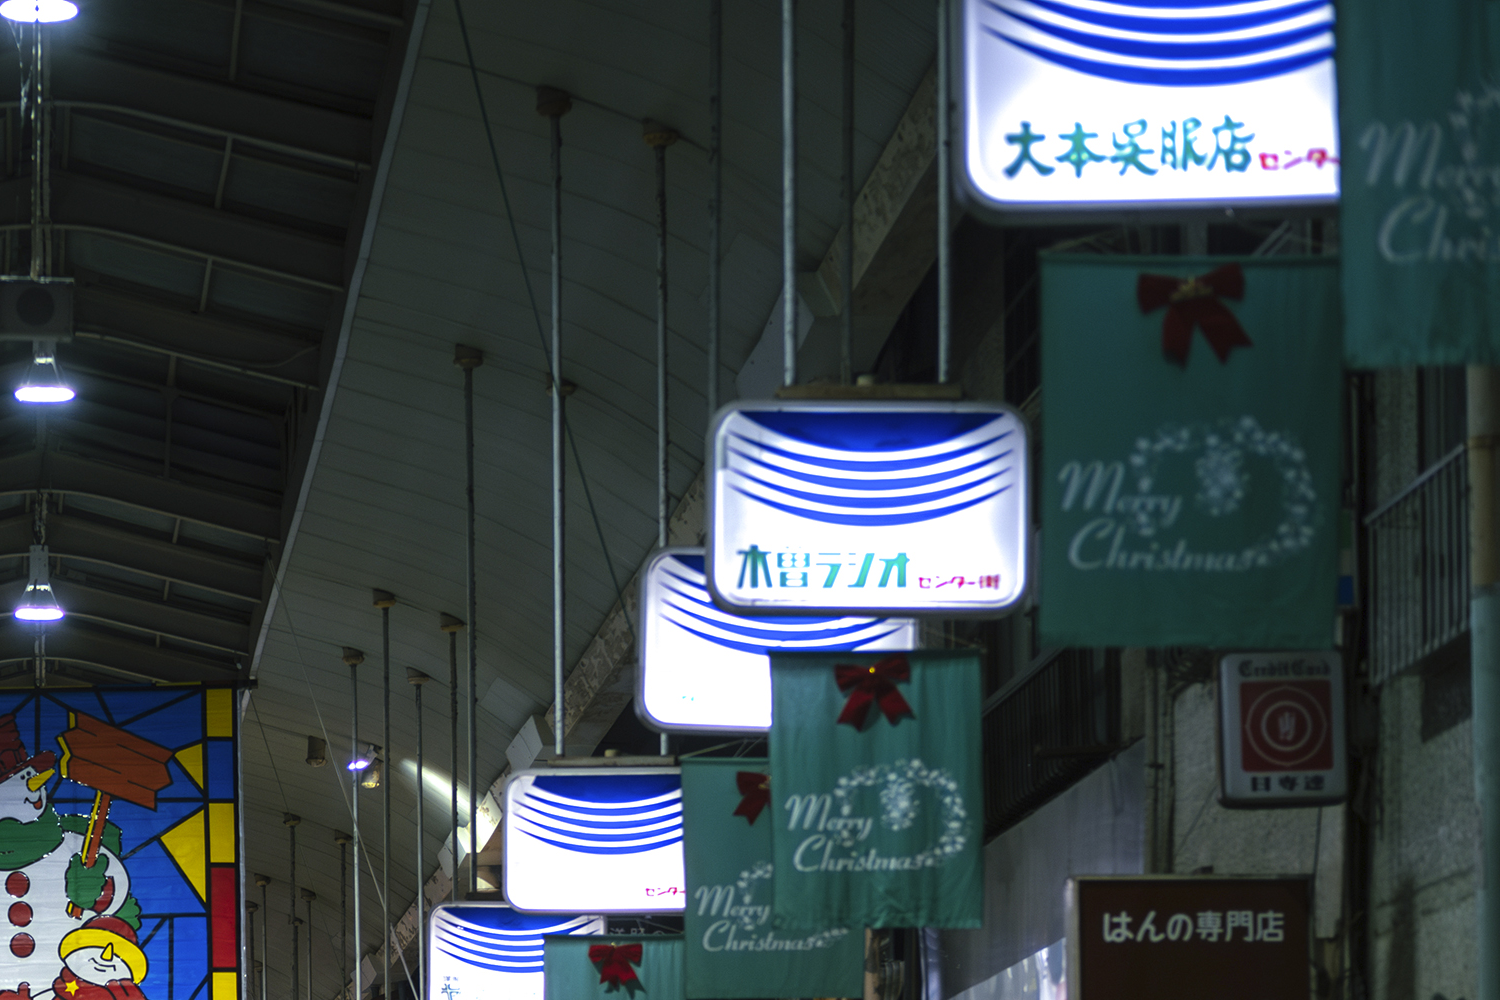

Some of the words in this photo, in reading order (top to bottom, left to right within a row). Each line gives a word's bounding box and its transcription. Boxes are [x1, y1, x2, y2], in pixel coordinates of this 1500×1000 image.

[1057, 460, 1182, 528] Merry
[1068, 517, 1248, 571] Christmas
[785, 794, 872, 841] Merry
[793, 834, 921, 872] Christmas
[695, 885, 770, 923] Merry
[702, 921, 813, 953] Christmas
[1102, 910, 1285, 943] はんの専門店
